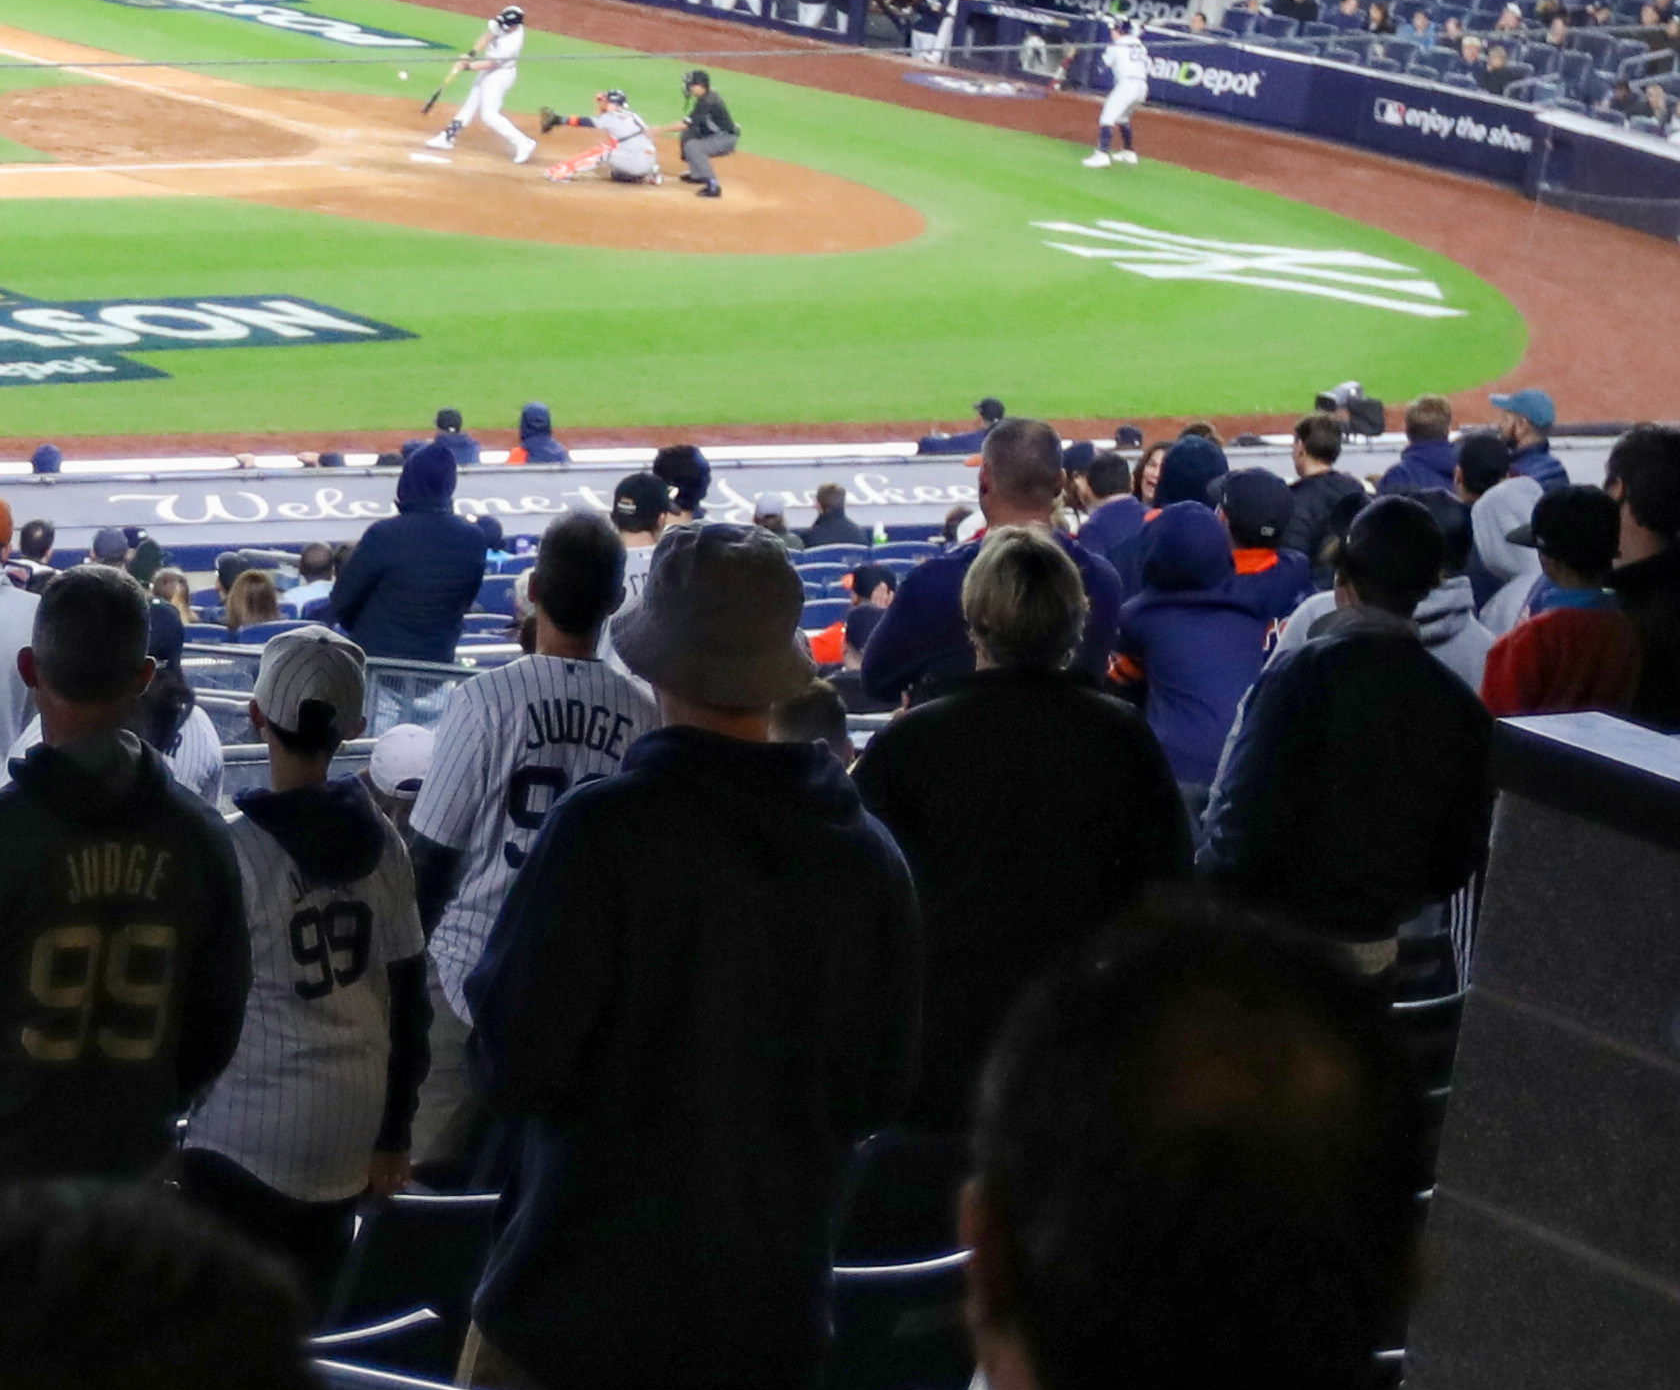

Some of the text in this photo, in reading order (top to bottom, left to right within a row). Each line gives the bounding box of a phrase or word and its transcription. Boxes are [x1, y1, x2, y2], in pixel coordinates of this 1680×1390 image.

[1405, 108, 1455, 139] enjoy
[1455, 116, 1487, 142] the
[107, 486, 566, 525] Welcme
[526, 697, 634, 762] JUDGE
[65, 842, 172, 904] JUDGE
[289, 900, 374, 1001] 99
[20, 923, 180, 1063] 99
